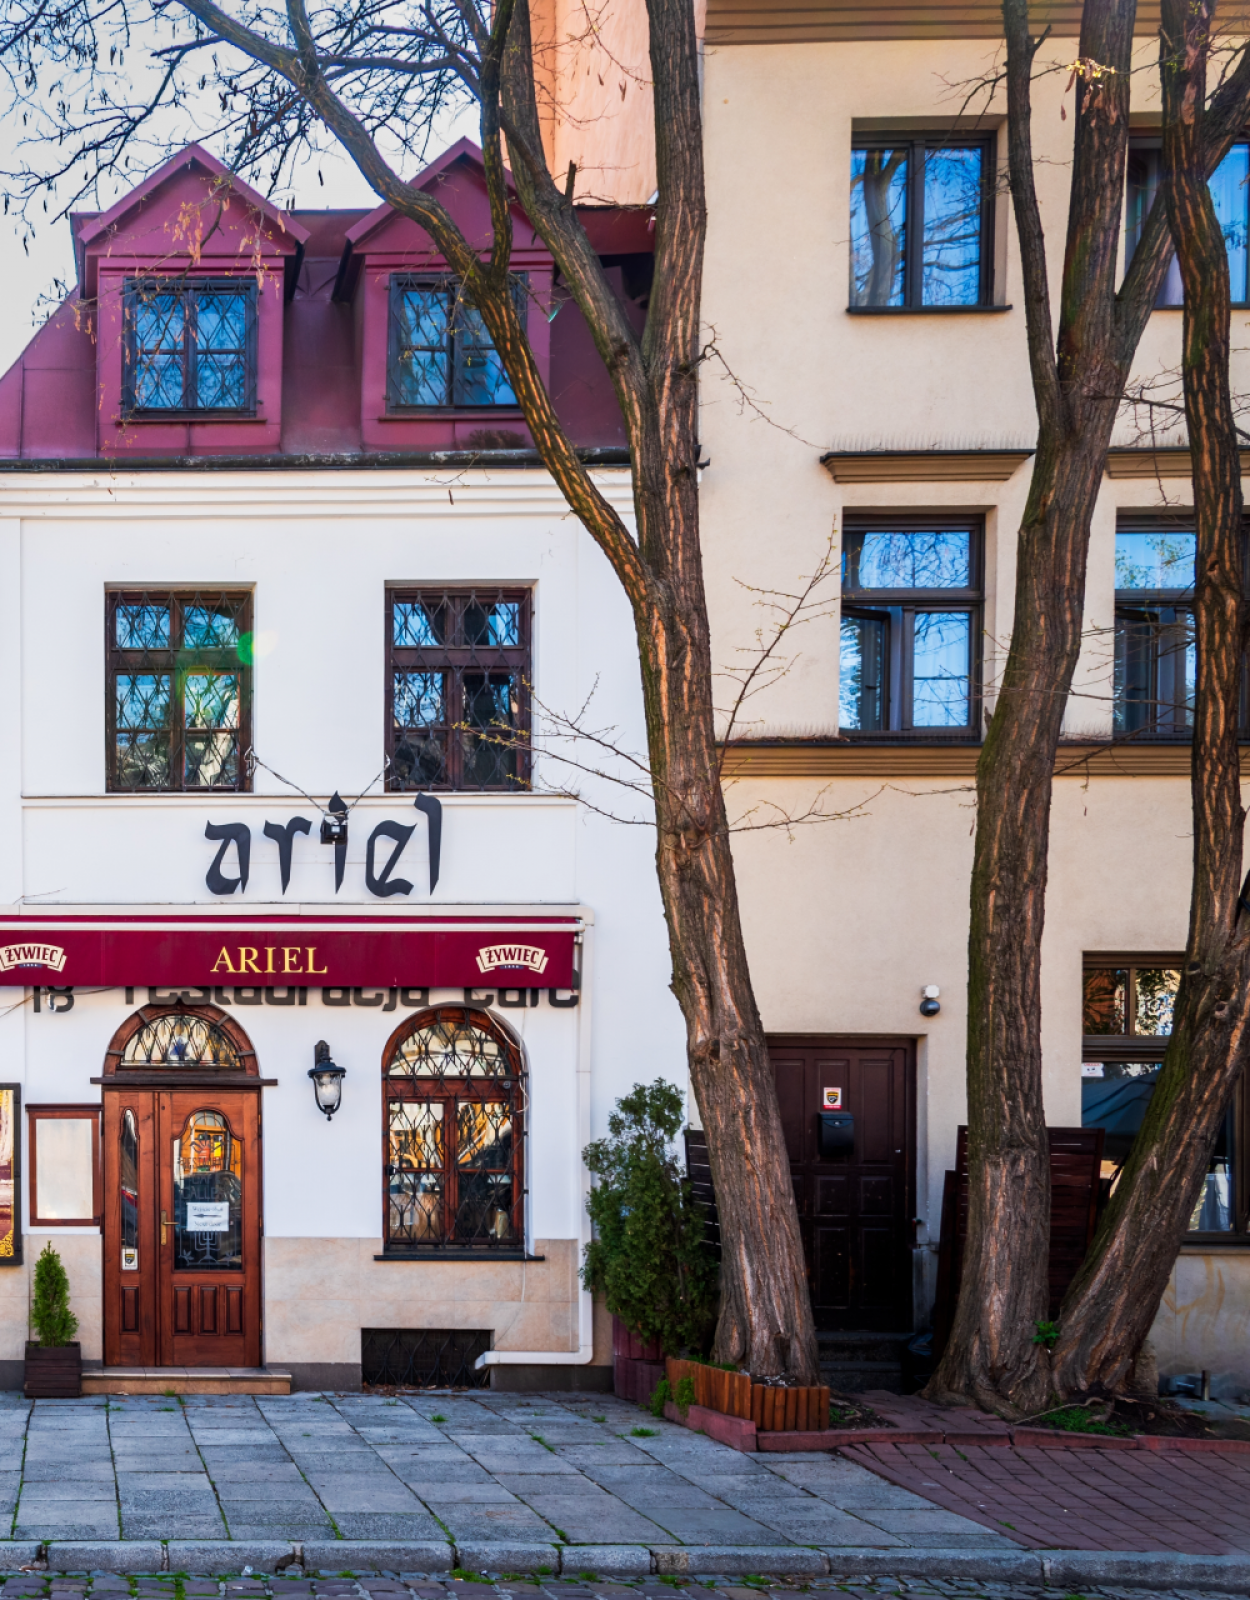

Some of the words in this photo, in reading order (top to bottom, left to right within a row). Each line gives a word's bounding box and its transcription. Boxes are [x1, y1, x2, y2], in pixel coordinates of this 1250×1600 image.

[204, 790, 443, 898] ariel
[5, 946, 59, 963] ŻYWIEC
[210, 946, 328, 974] ARIEL
[485, 947, 540, 965] ŻYWIEC
[33, 986, 75, 1013] 18
